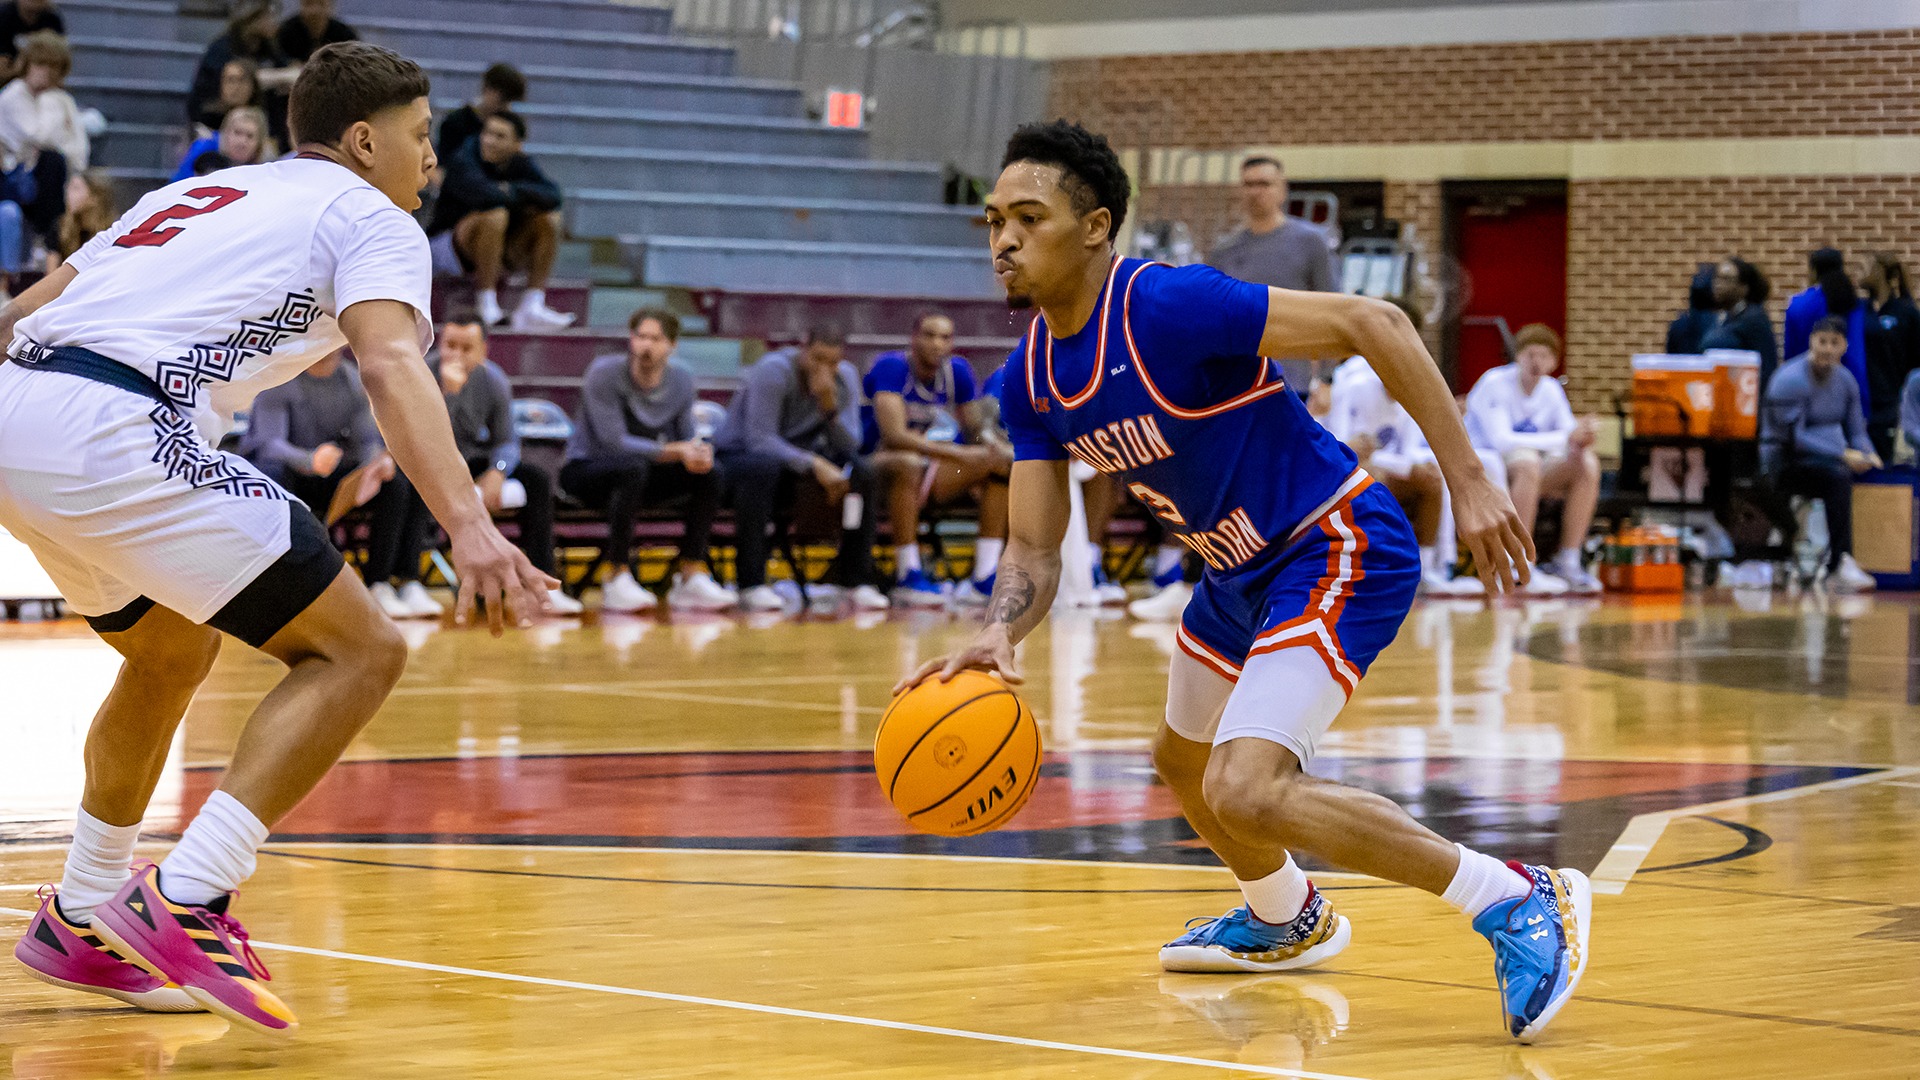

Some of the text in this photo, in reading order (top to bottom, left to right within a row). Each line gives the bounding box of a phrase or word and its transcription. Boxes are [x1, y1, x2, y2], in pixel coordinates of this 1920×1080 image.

[112, 186, 249, 248] 2
[1062, 414, 1175, 473] OUSTON
[1127, 482, 1186, 525] 3
[966, 766, 1017, 820] EVO
